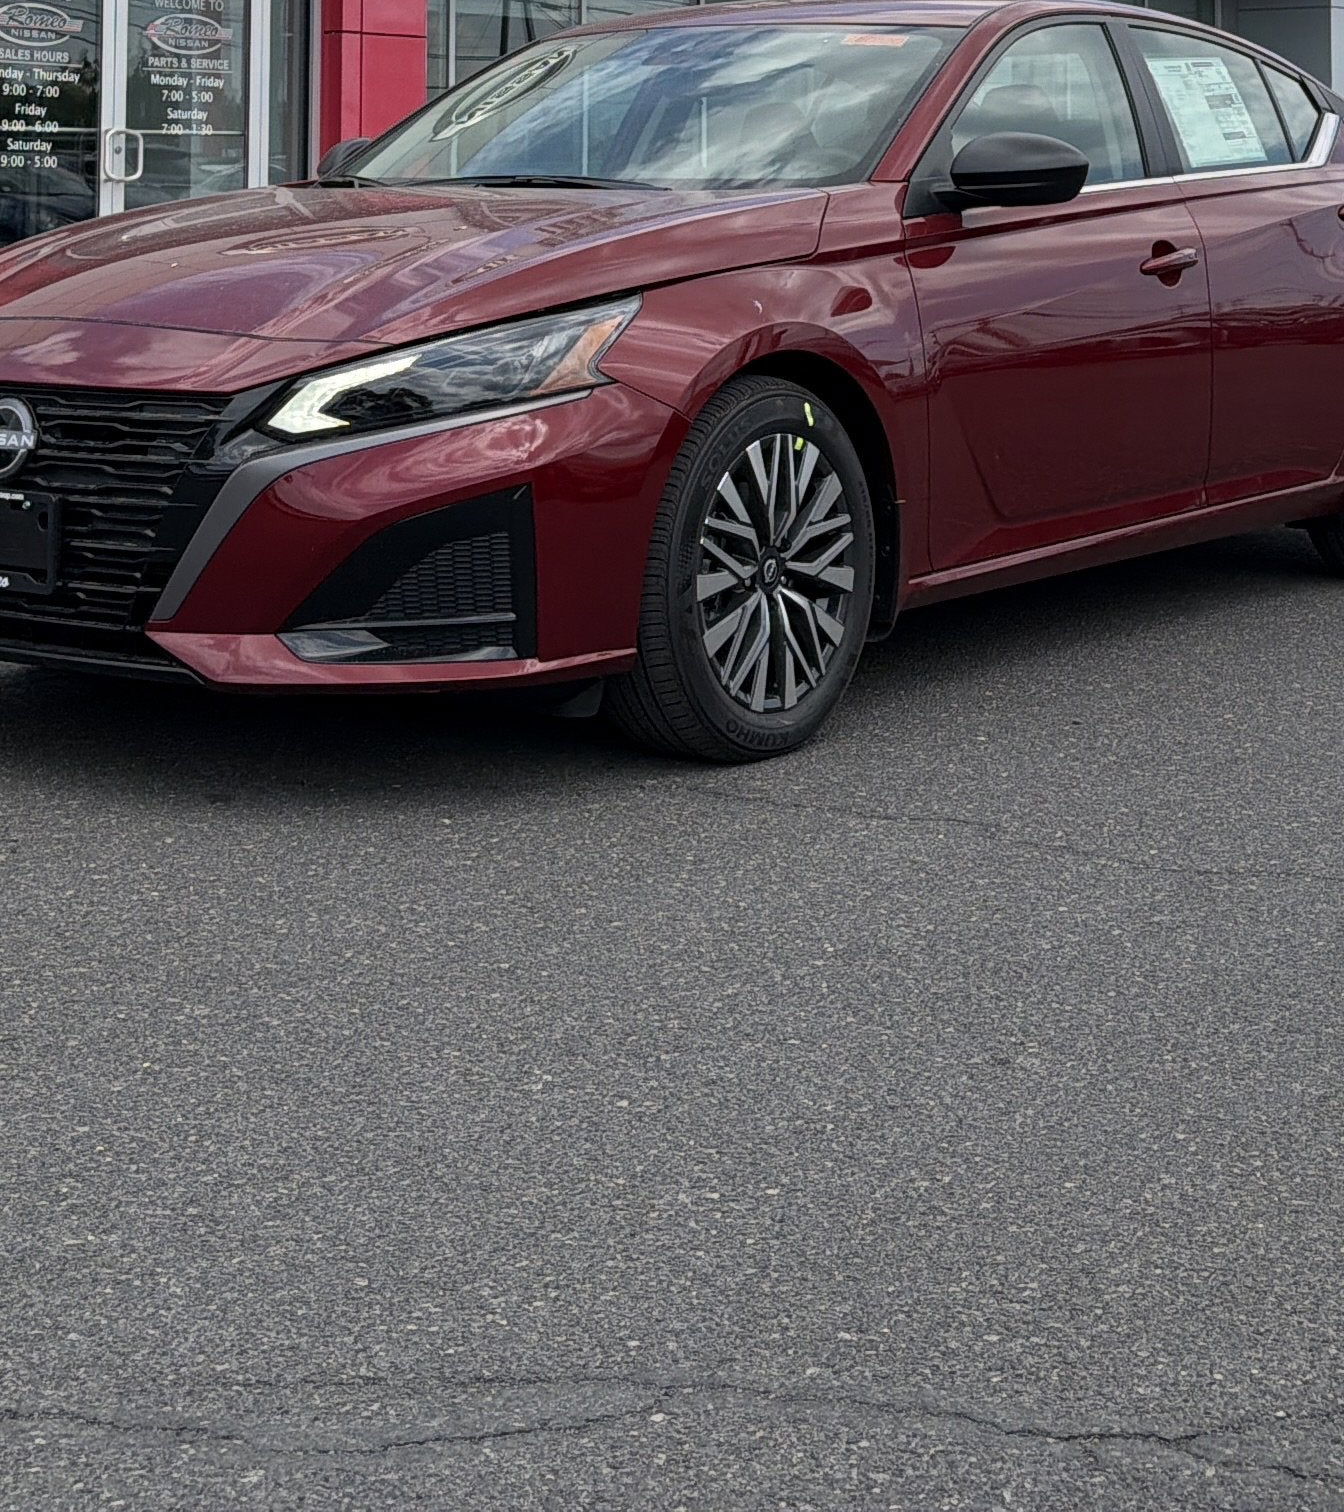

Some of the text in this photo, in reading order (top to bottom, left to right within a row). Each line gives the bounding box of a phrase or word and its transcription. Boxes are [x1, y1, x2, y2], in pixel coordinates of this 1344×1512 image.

[209, 0, 224, 12] TO
[5, 5, 67, 29] Romeo
[162, 17, 219, 37] Romeo
[10, 29, 56, 40] NISSAN
[168, 38, 208, 48] NISSAN
[33, 50, 70, 63] HOURS
[148, 56, 230, 70] PARTS & SERVICE
[33, 68, 80, 84] Thursday
[150, 74, 188, 87] Monday
[196, 75, 225, 89] Friday
[2, 84, 27, 97] 9:00
[36, 86, 60, 98] 7:00
[161, 90, 184, 102] 7:00
[192, 91, 214, 103] 5:00
[14, 103, 47, 118] Friday
[166, 108, 209, 121] Saturday
[1, 119, 26, 132] 9:00
[34, 120, 59, 133] 6:00
[161, 123, 184, 135] 7:00
[192, 124, 213, 136] 1:30
[7, 137, 53, 153] Saturday
[0, 155, 25, 168] 9:00
[34, 156, 58, 169] 5:00
[726, 719, 792, 747] KUMHO
